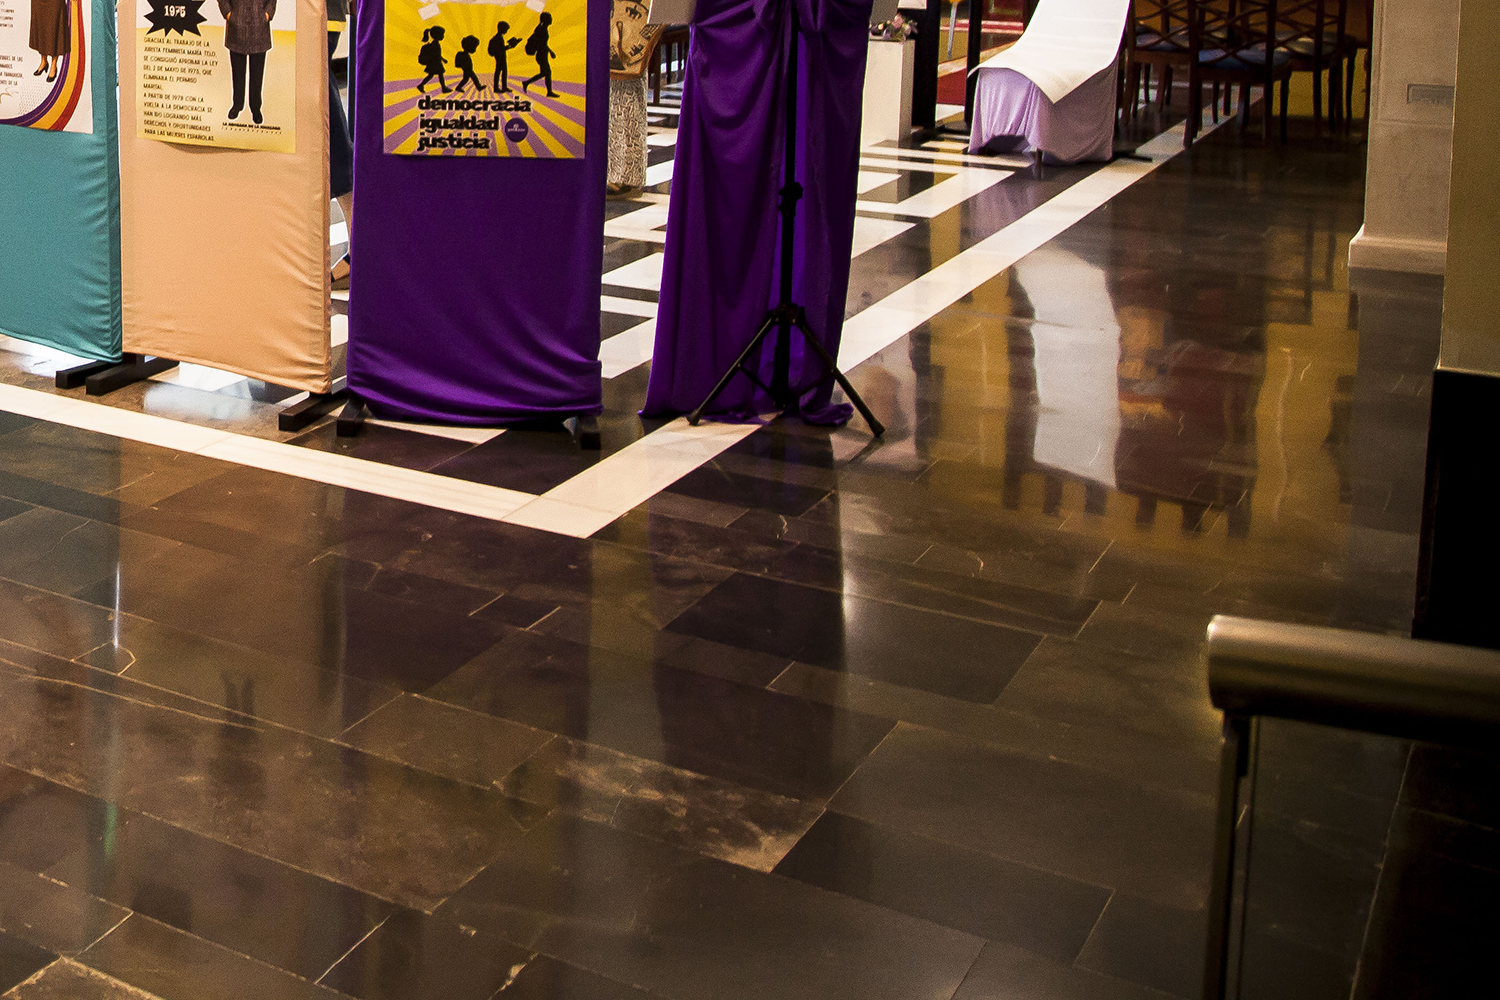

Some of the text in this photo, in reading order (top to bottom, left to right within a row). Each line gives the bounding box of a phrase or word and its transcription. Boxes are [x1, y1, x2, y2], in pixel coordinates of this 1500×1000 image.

[164, 5, 186, 17] 1975
[418, 95, 531, 112] democracia
[419, 114, 499, 133] igualdad
[417, 132, 490, 151] justicia
